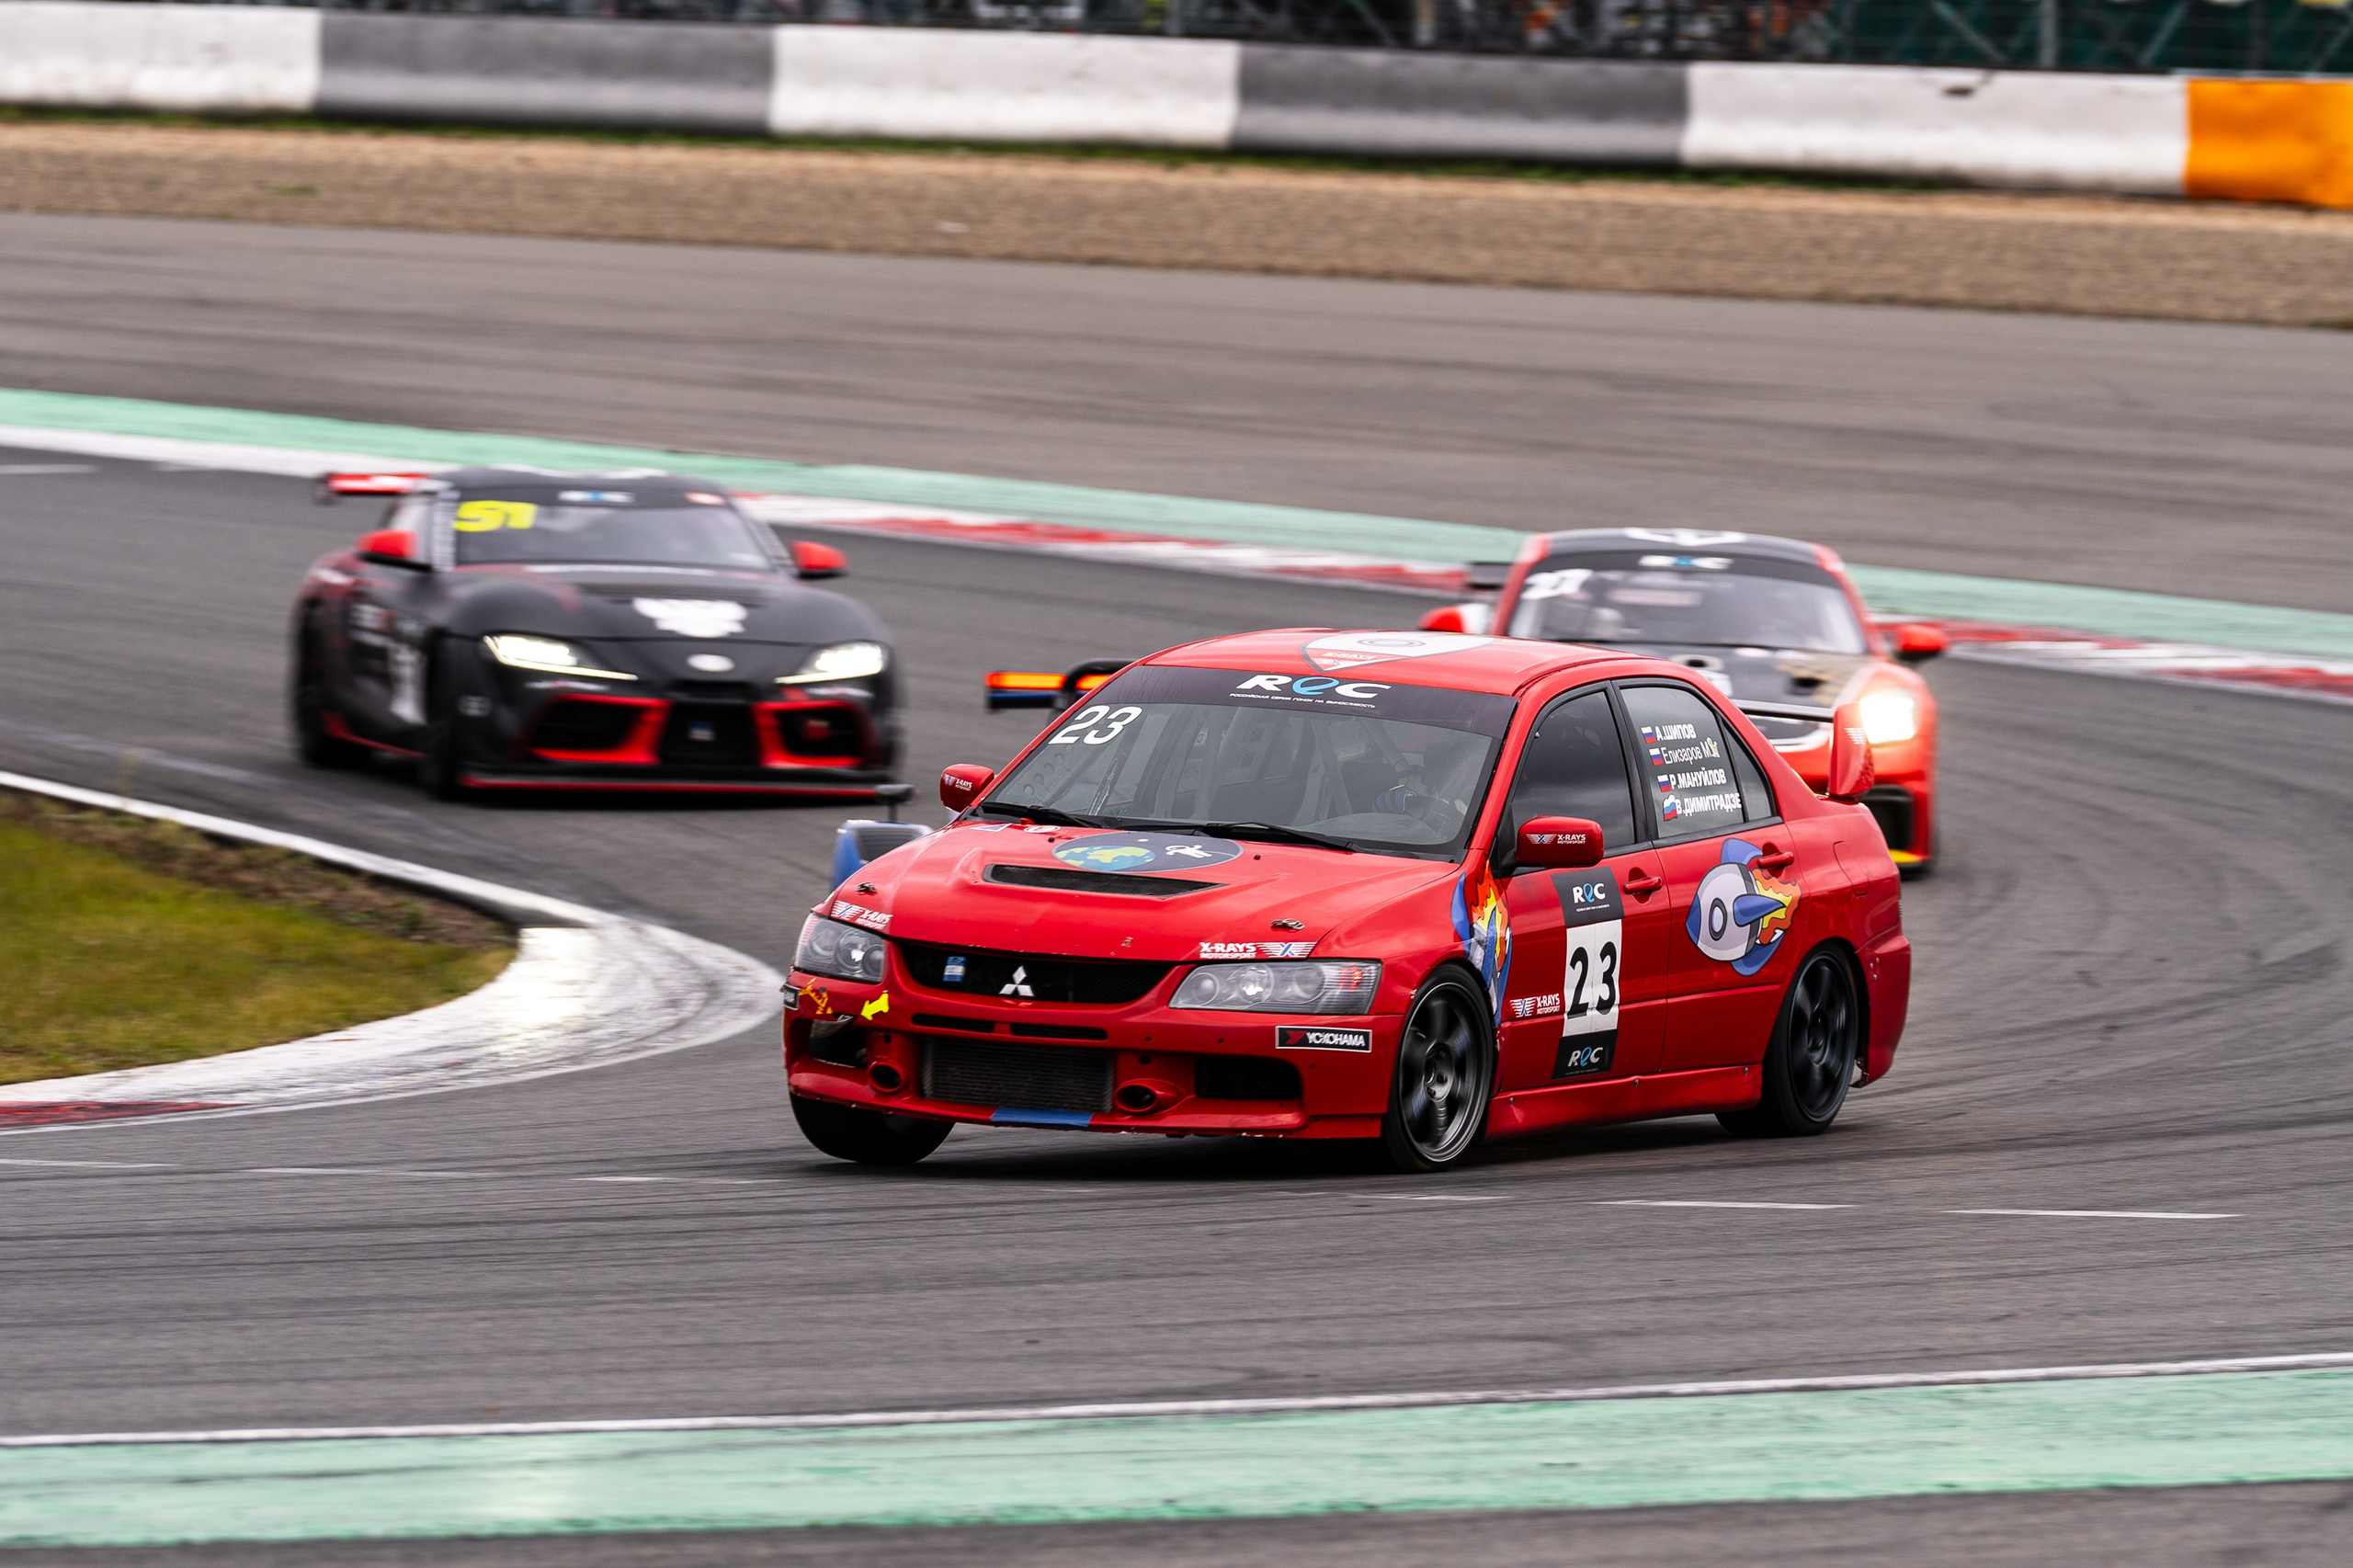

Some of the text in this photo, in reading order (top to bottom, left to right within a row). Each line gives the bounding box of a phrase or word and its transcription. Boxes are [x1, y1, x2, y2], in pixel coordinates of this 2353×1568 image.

[1048, 705, 1142, 744] 23
[1655, 723, 1697, 742] А.ШИПОВ
[1661, 745, 1703, 765] Елизаров
[1669, 767, 1727, 790] Р.МАНУЙЛОВ
[1676, 792, 1743, 817] В.ДИМИТРАДЗЕ
[1199, 941, 1256, 953] X-RAYS
[1199, 951, 1256, 960] MOTORSPORT
[1566, 940, 1618, 1019] 23
[1537, 993, 1561, 1008] X-RAYS
[1306, 1031, 1366, 1047] YOKOHAMA
